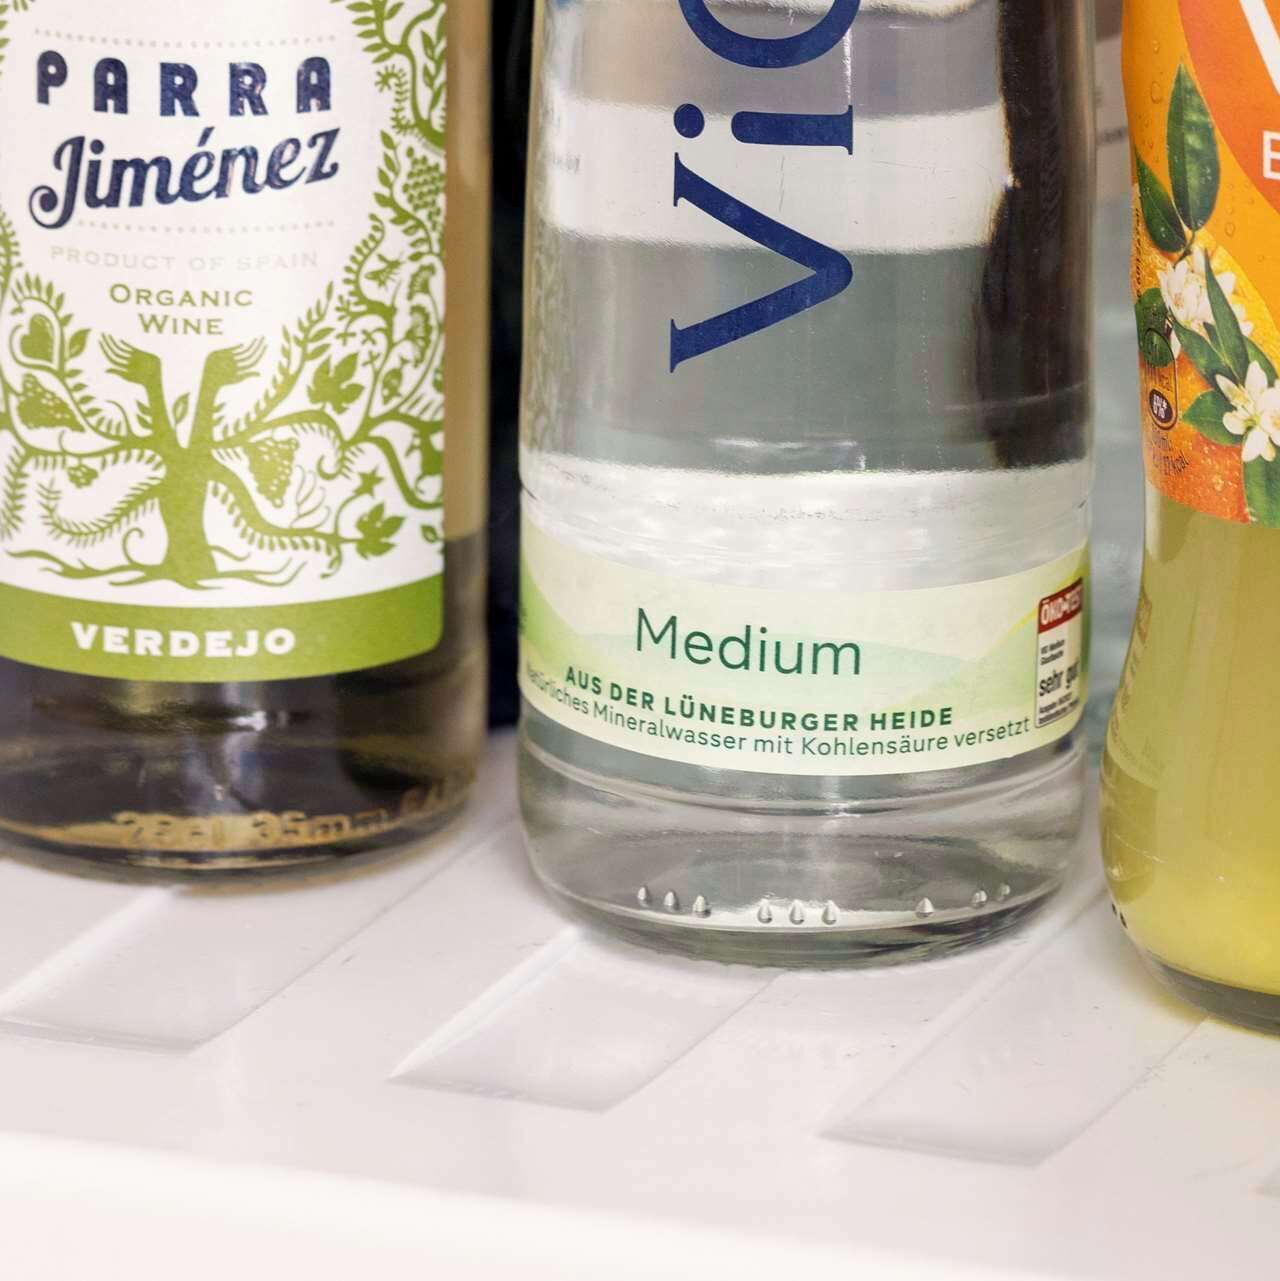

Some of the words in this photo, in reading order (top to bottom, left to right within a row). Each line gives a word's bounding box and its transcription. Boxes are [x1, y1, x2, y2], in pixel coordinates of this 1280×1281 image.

[36, 49, 332, 117] PARRA
[28, 126, 340, 229] Jiménez
[51, 245, 175, 271] PRODUCT
[188, 255, 224, 271] OF
[236, 251, 319, 271] SPAIN
[109, 283, 253, 307] ORGANIC
[138, 313, 224, 336] WINE
[70, 621, 296, 658] VERDEJO
[636, 607, 862, 676] Medium
[565, 666, 602, 696] AUS
[610, 682, 655, 712] DER
[665, 694, 859, 733] LÜNEBURGER
[870, 706, 954, 732] HEIDE
[593, 700, 744, 752] Mineralwasser
[754, 734, 794, 756] mit
[801, 732, 949, 757] Kohlensäure
[954, 716, 1031, 749] versetzt
